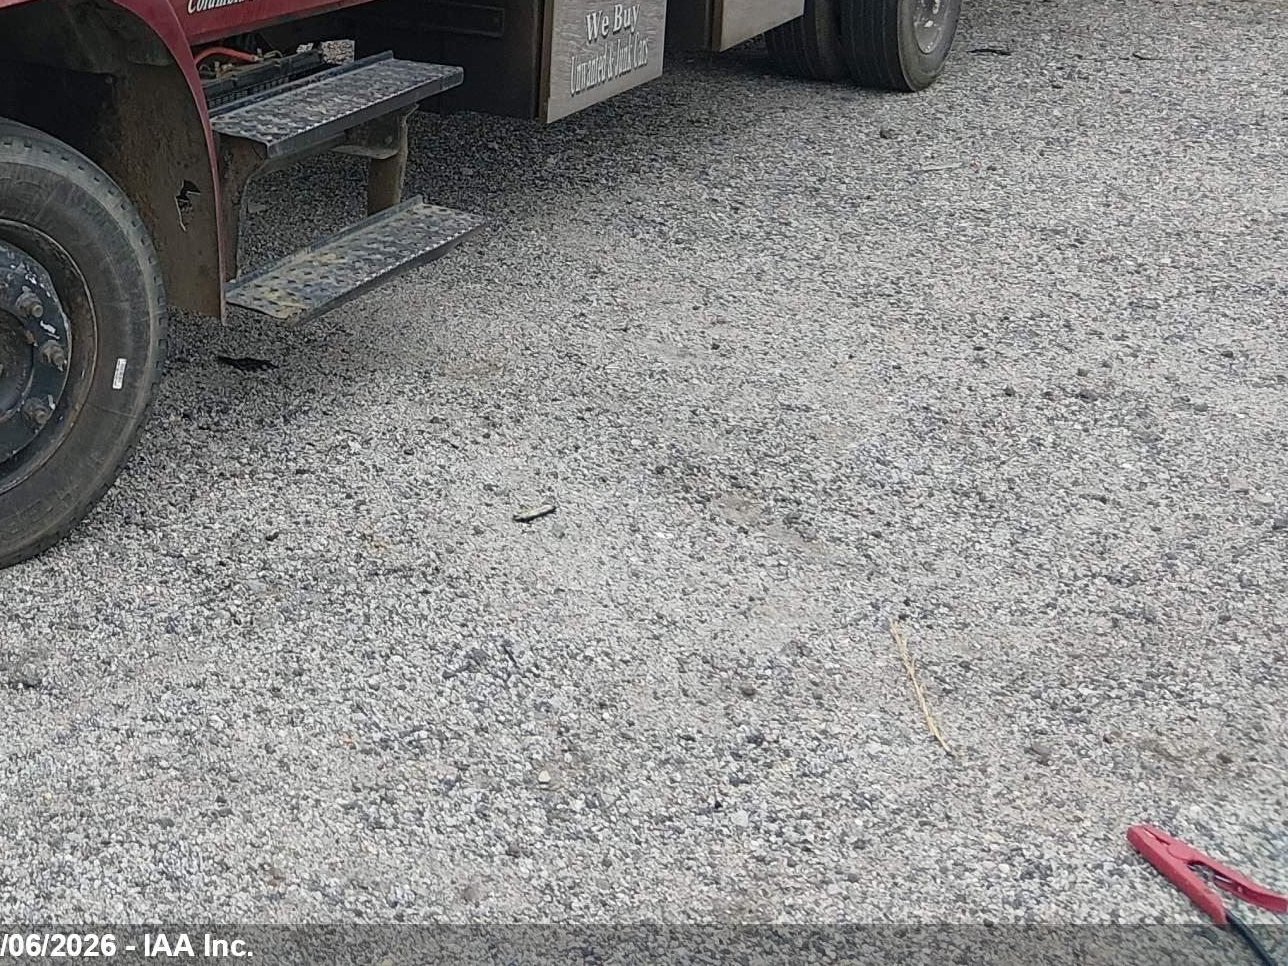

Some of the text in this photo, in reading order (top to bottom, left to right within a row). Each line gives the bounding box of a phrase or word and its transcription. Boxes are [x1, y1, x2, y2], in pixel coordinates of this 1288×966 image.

[585, 3, 641, 44] We Buy
[570, 41, 608, 97] Unwanted
[633, 31, 649, 70] Cars
